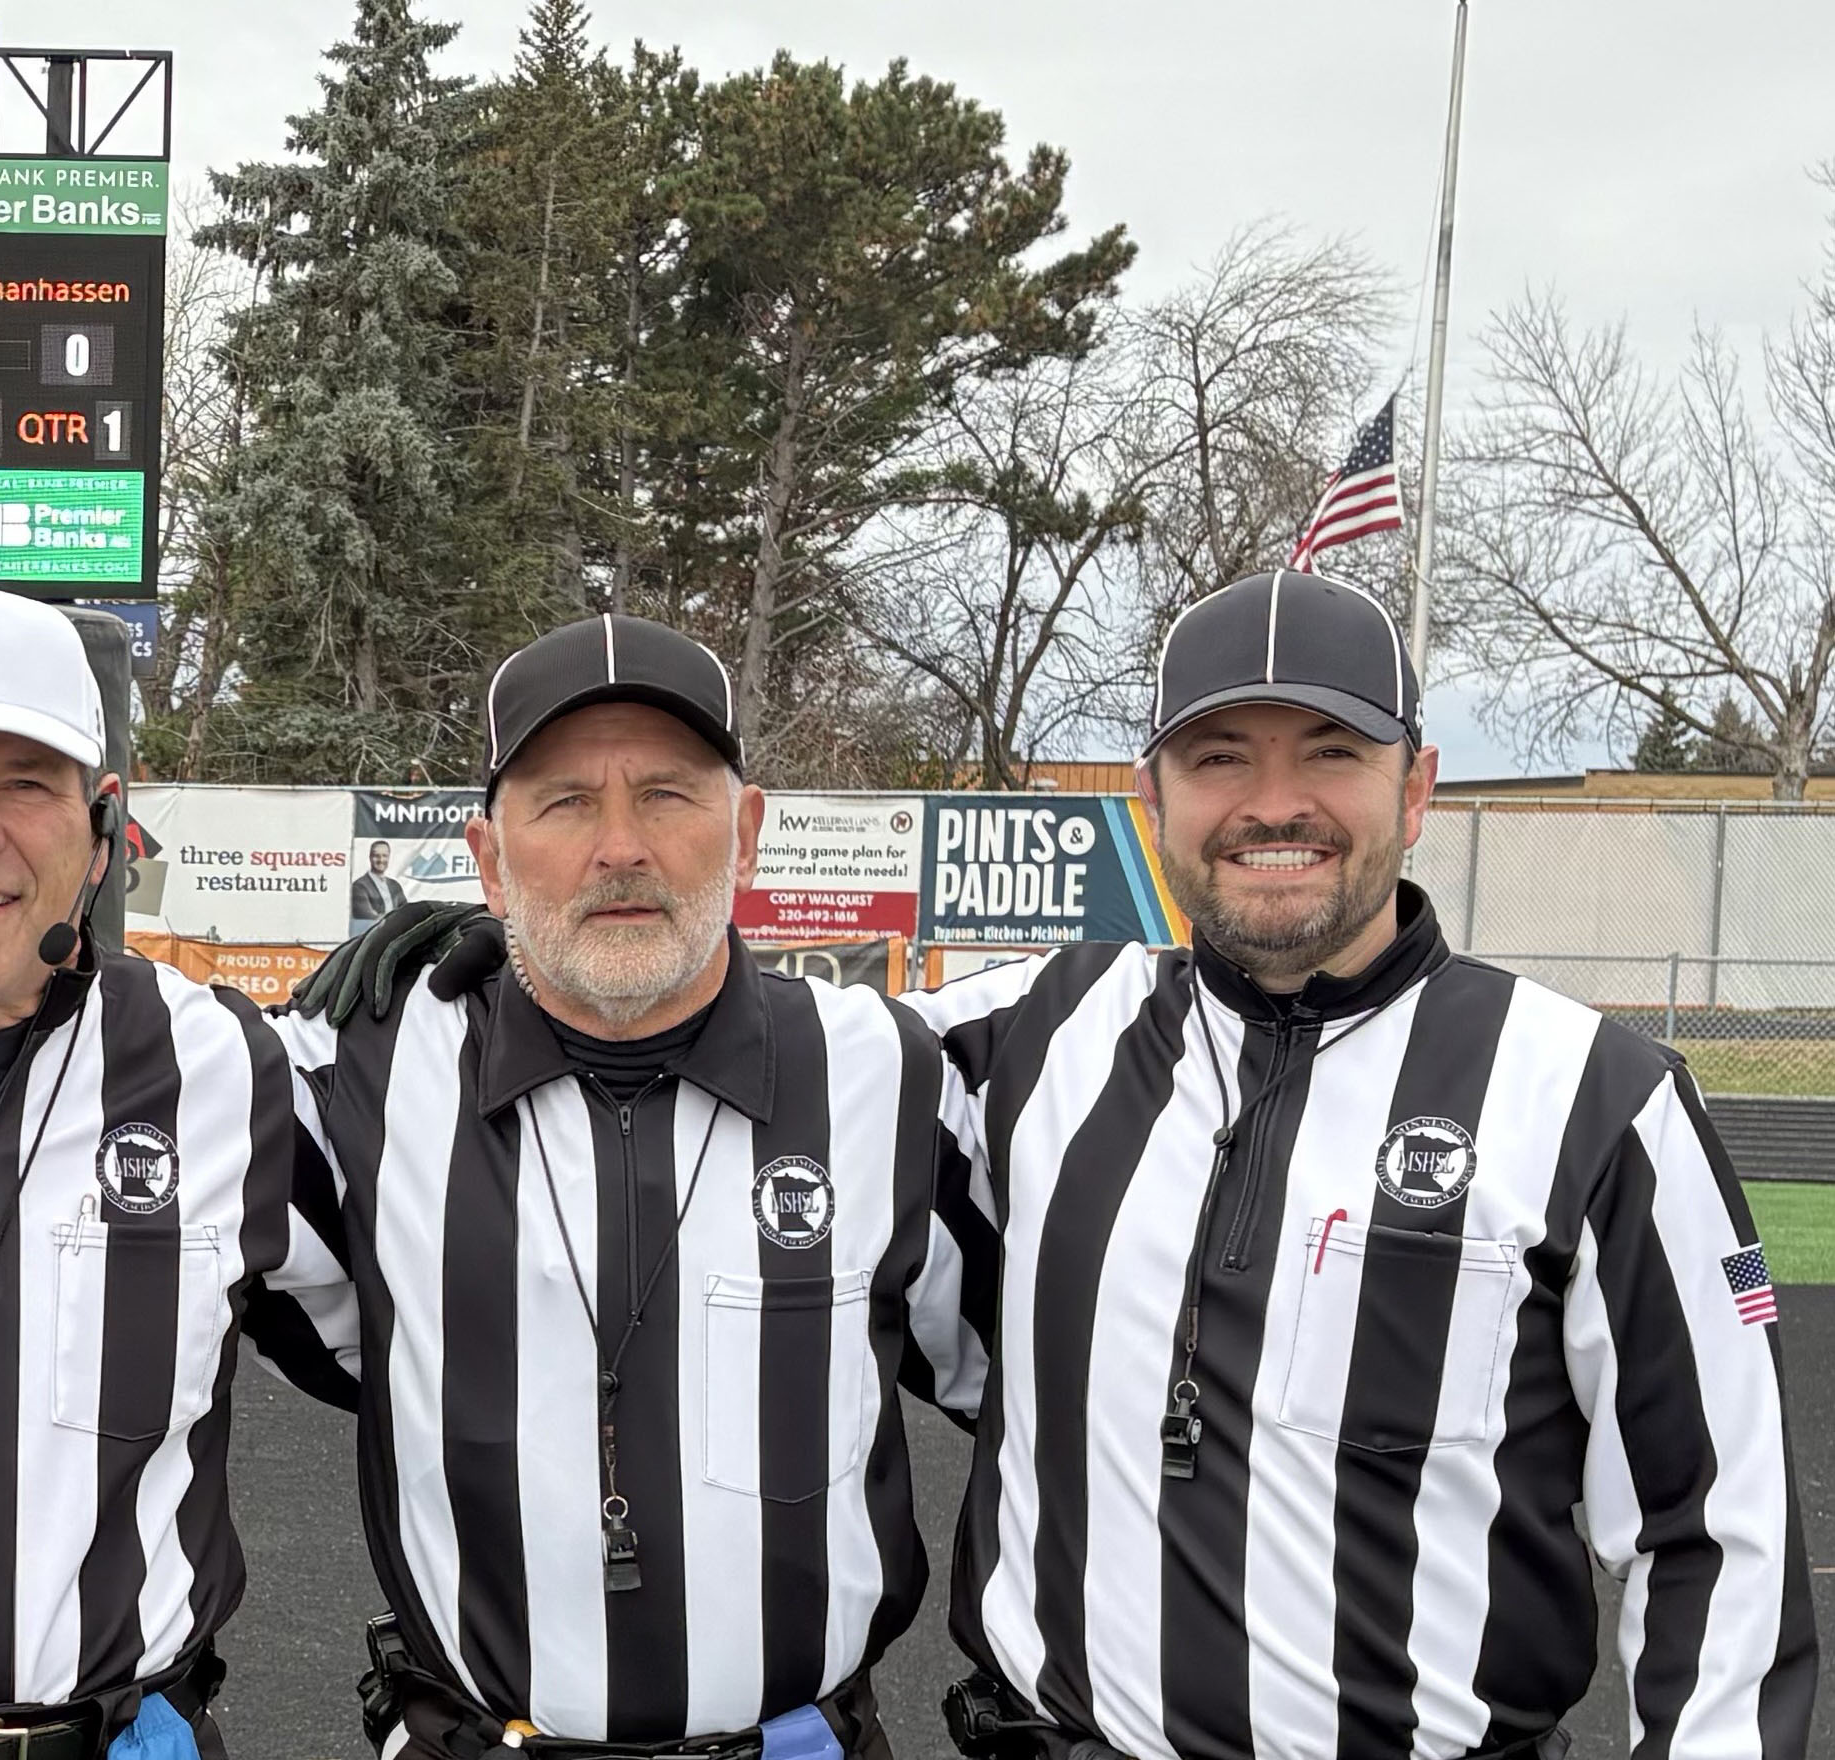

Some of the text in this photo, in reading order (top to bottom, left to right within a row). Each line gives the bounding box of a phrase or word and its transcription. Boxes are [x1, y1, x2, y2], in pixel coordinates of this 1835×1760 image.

[56, 170, 160, 188] PREMIER.
[33, 194, 140, 225] Banks
[65, 333, 90, 377] 0
[18, 410, 121, 451] QTR 1
[34, 504, 125, 525] Premier
[779, 809, 810, 831] kw
[937, 808, 1084, 863] PINTS &
[180, 846, 346, 871] three squares
[811, 848, 848, 860] game
[852, 845, 882, 860] plan
[886, 845, 906, 858] for
[789, 863, 816, 874] real
[819, 866, 861, 876] estate
[864, 864, 908, 877] needs!
[196, 873, 328, 893] restaurant
[934, 863, 1087, 917] PADDLE
[769, 892, 874, 907] CORY WALQUIST
[217, 954, 271, 969] PROUD
[276, 956, 295, 969] TO
